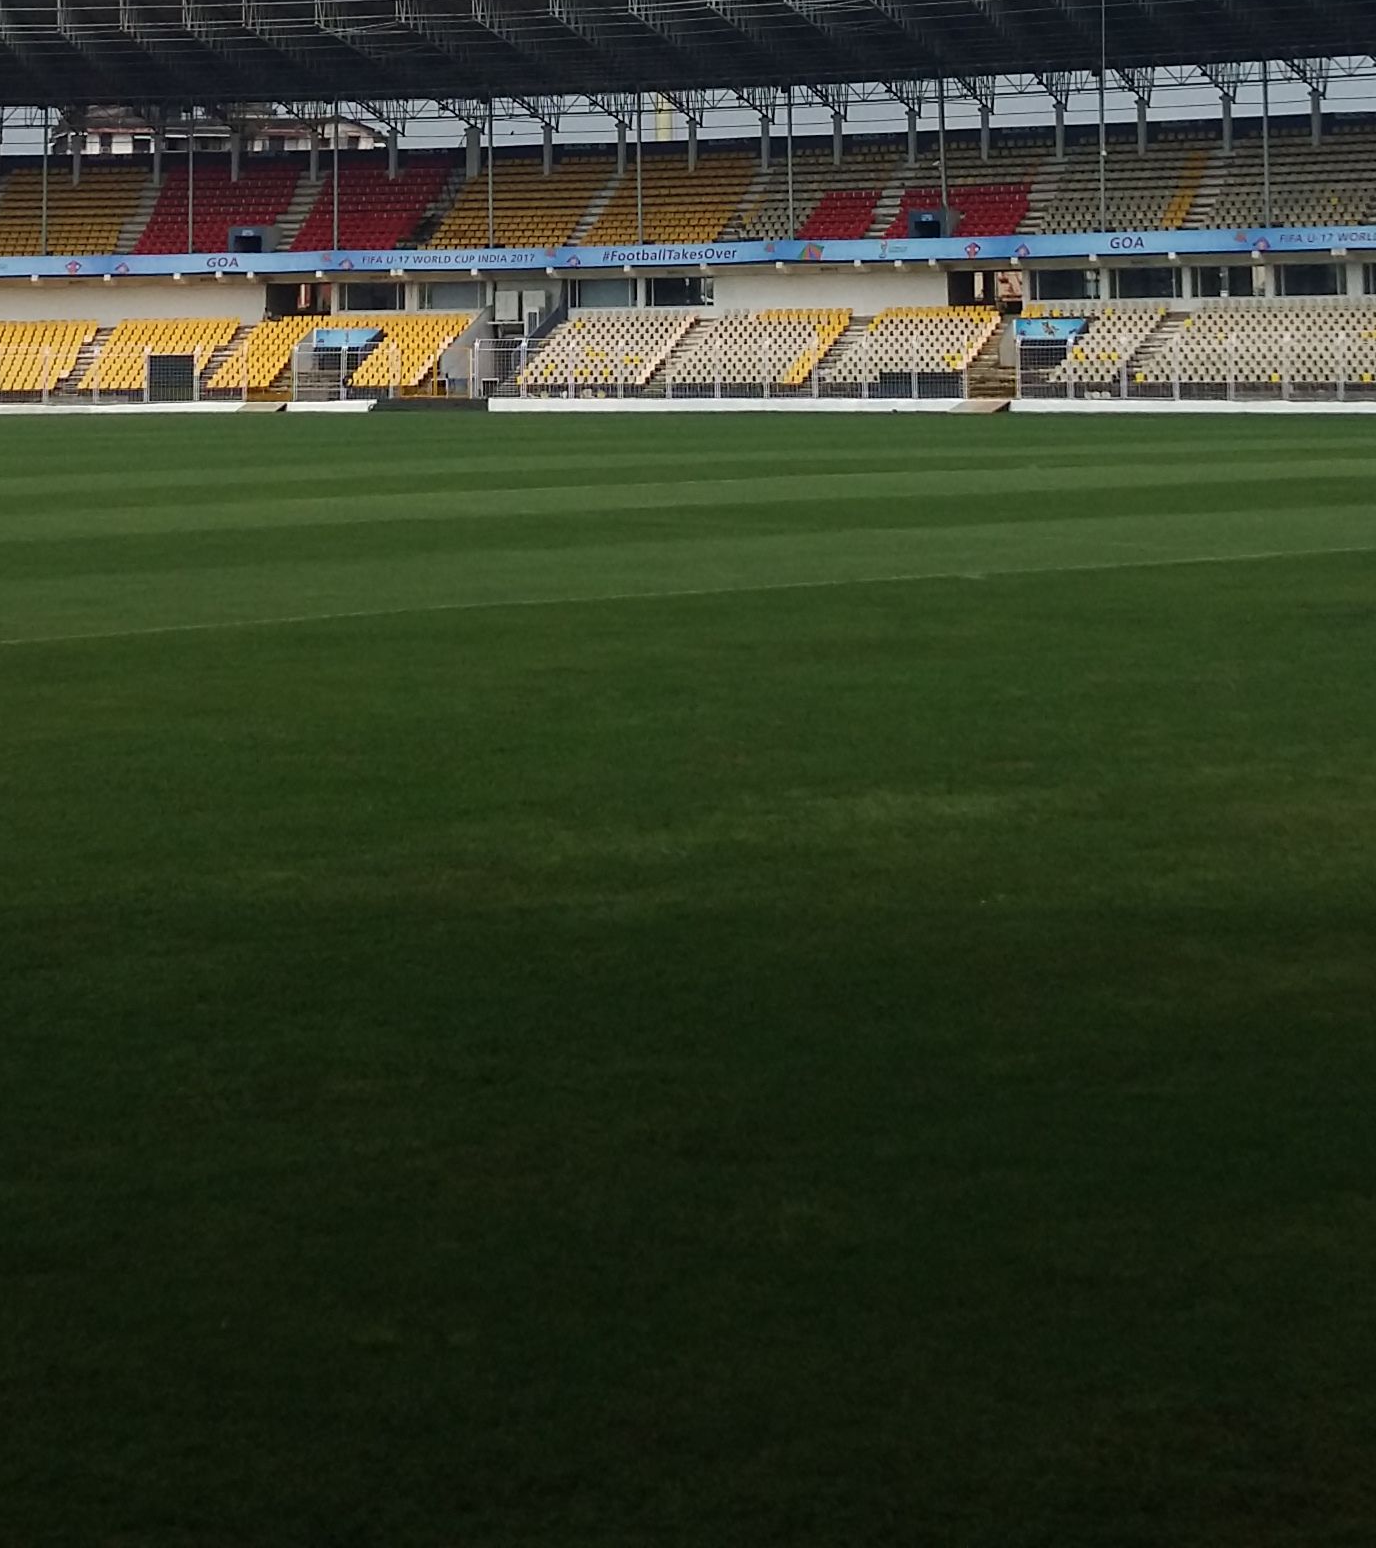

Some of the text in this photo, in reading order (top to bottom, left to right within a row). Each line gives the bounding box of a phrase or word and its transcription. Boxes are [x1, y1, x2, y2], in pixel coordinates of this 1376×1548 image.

[1110, 236, 1145, 249] GOA
[1280, 234, 1305, 243] FIFA
[362, 253, 535, 264] FIFA U-17 WORLD CUP INDIA 2017
[602, 248, 738, 262] #FootballTakesOver
[206, 257, 239, 268] GOA
